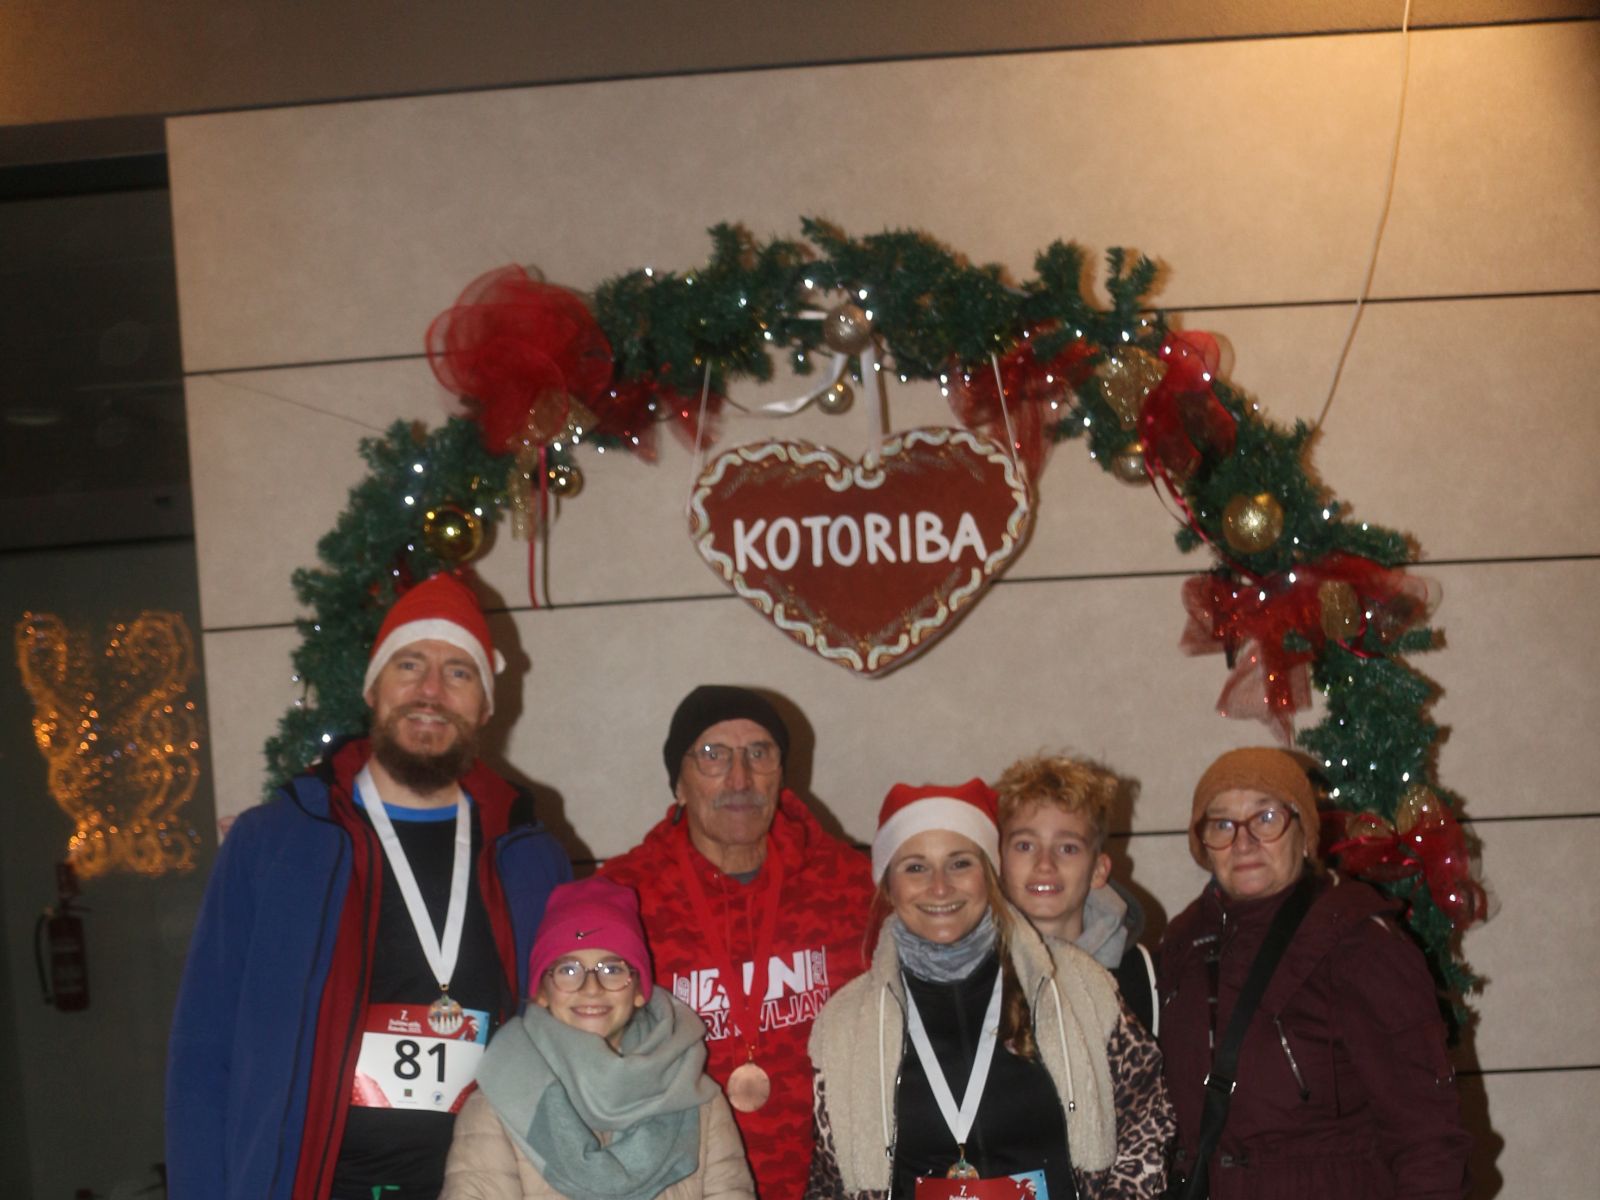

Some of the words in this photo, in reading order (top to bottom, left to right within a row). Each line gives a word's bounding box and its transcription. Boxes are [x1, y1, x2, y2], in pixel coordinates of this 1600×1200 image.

[733, 511, 987, 573] KOTORIBA
[394, 1039, 446, 1083] 81
[960, 1184, 968, 1197] 7.
